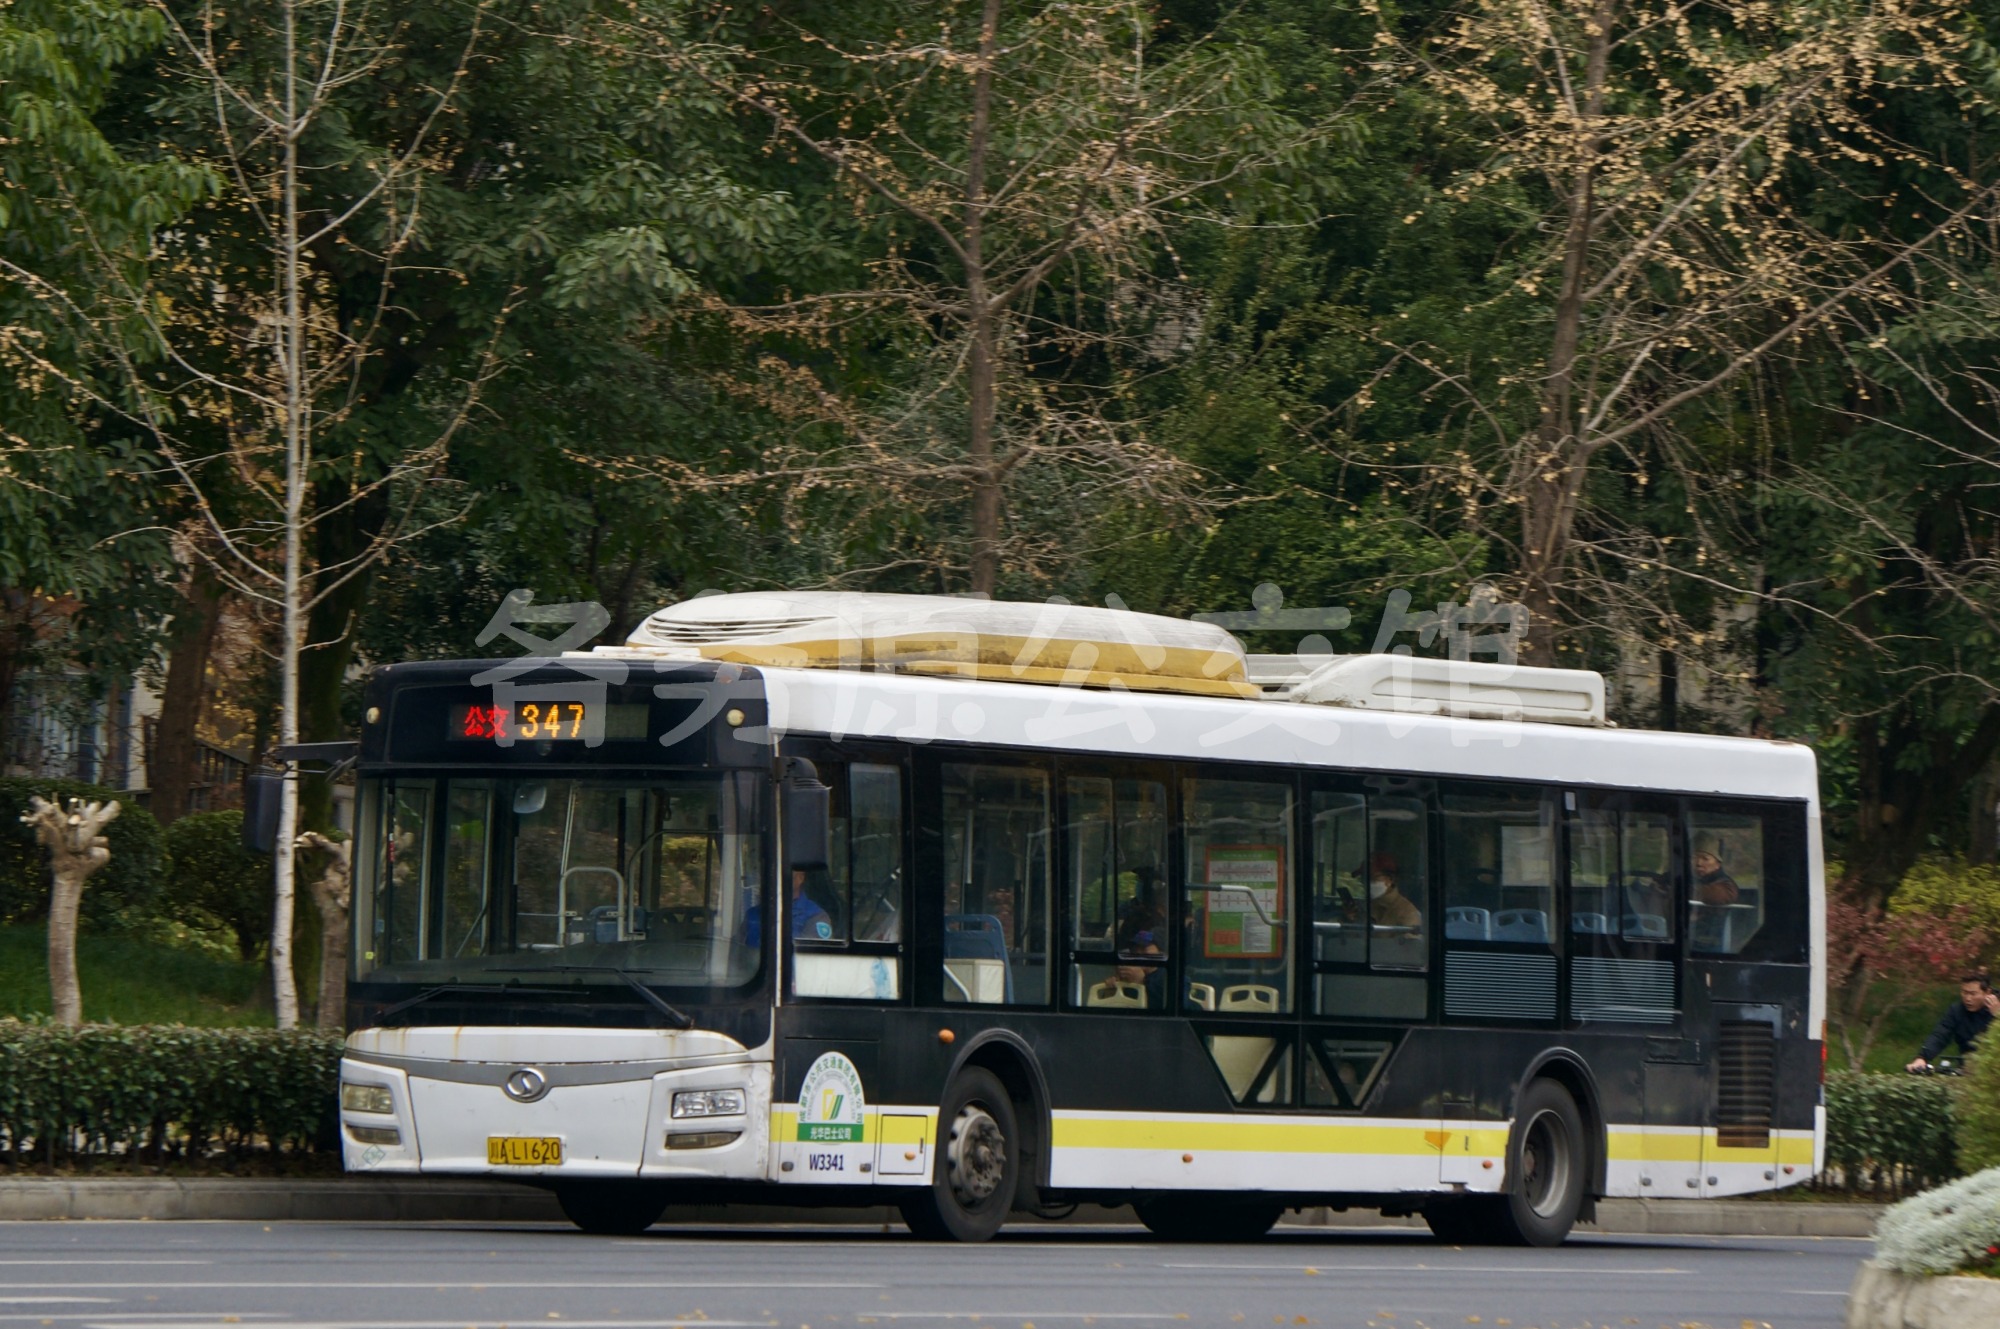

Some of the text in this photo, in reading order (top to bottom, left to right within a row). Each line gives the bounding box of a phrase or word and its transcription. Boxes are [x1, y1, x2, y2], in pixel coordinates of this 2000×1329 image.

[464, 704, 584, 738] 公交 347
[810, 1127, 852, 1140] 光华巴士公司
[809, 1153, 844, 1171] W3341
